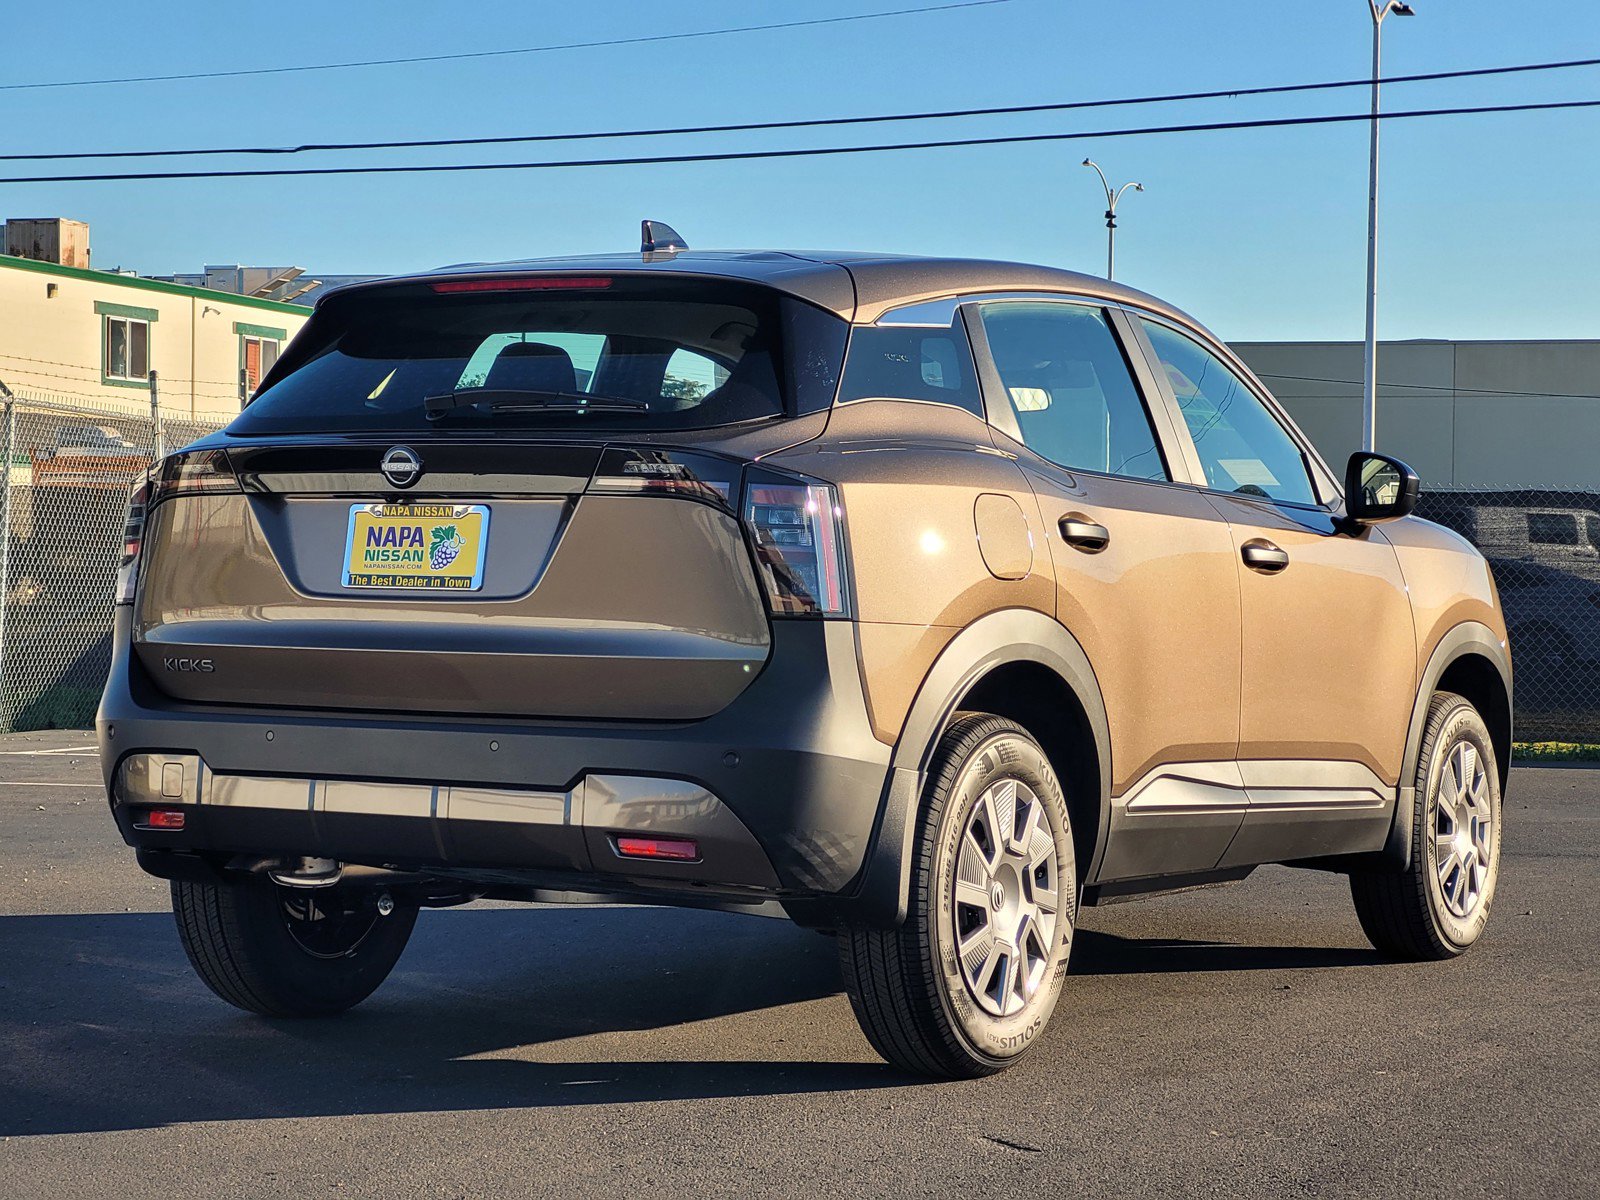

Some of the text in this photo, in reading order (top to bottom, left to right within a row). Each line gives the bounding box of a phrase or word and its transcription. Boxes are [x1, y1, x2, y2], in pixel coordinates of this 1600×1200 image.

[381, 462, 420, 472] NISSAN
[382, 506, 453, 517] NAPA NISSAN
[366, 526, 425, 548] NAPA
[364, 549, 424, 562] NISSAN
[350, 574, 471, 588] The Best Dealer in Town
[163, 657, 215, 672] KICKS
[1039, 759, 1069, 834] KUMHO
[999, 1015, 1042, 1049] SOLUS
